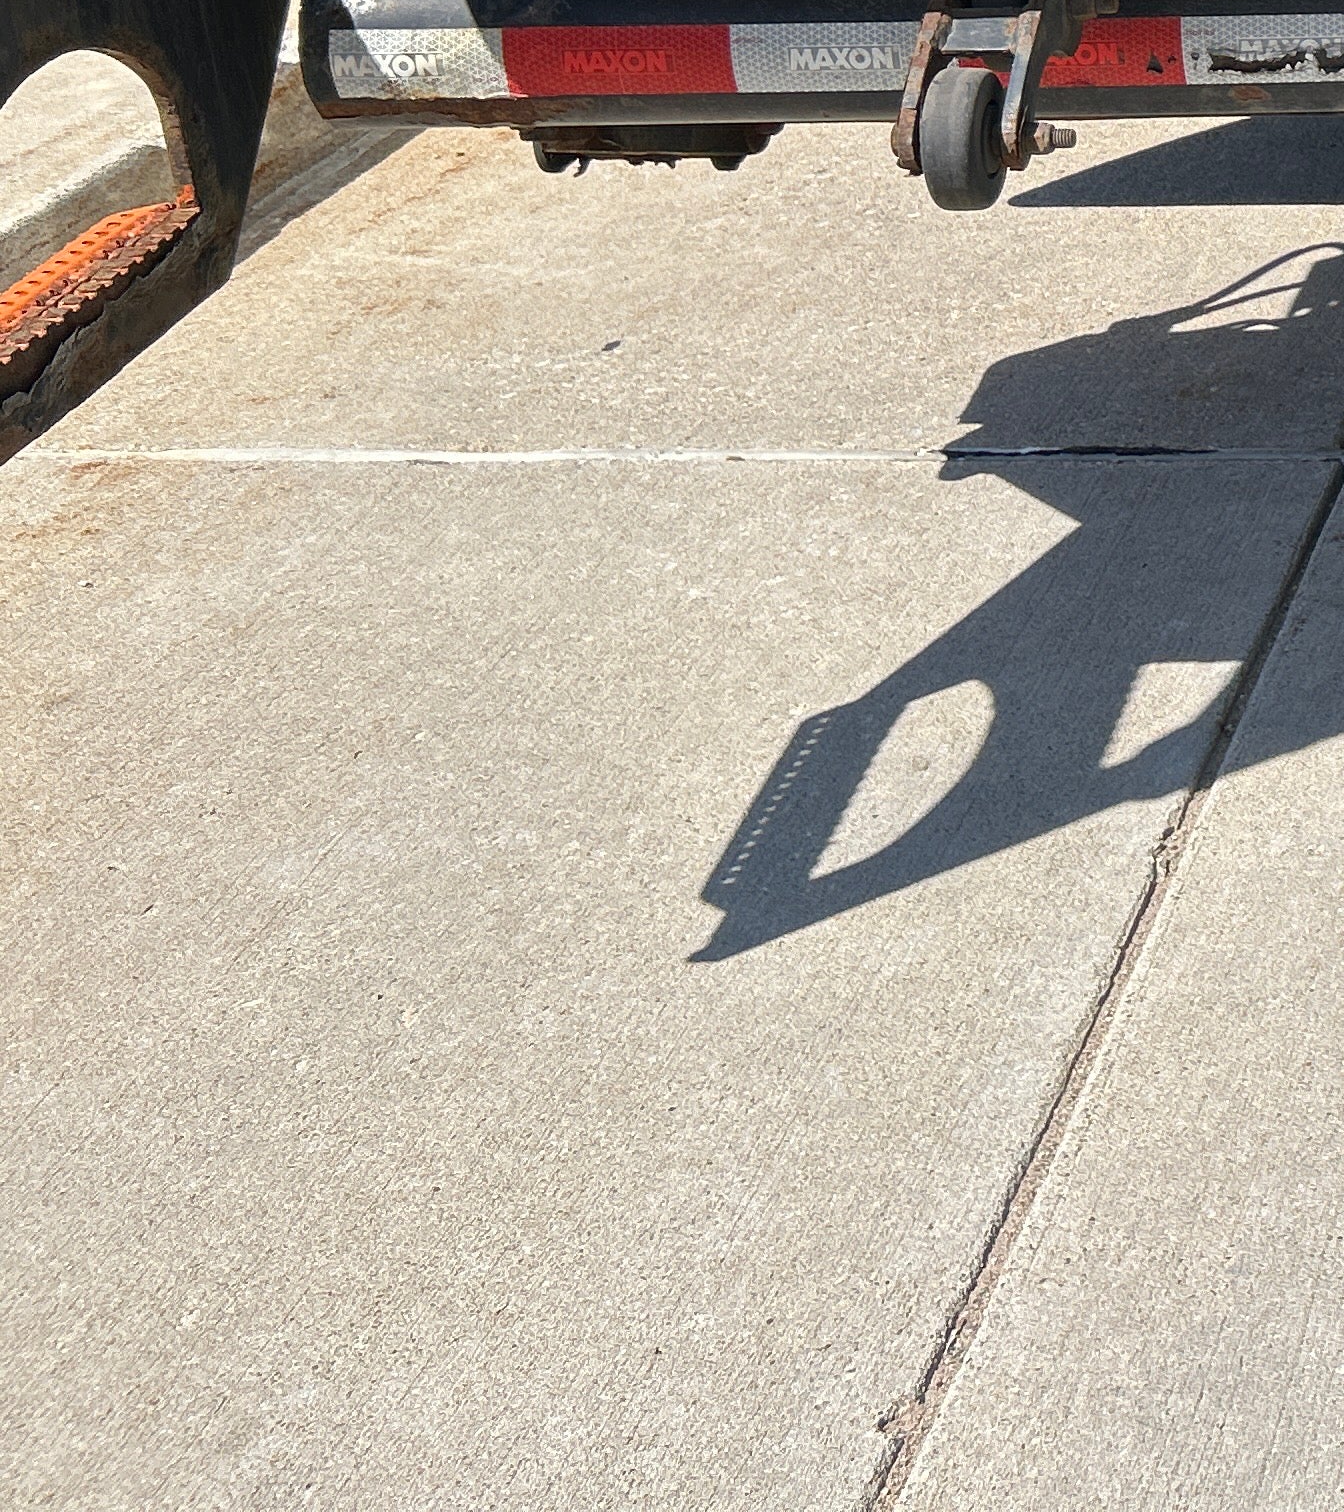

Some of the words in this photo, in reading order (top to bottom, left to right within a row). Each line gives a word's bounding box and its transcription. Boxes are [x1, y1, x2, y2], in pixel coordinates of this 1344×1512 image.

[332, 53, 439, 78] MAXON
[562, 50, 668, 74] MAXON
[789, 46, 895, 71] MAXON
